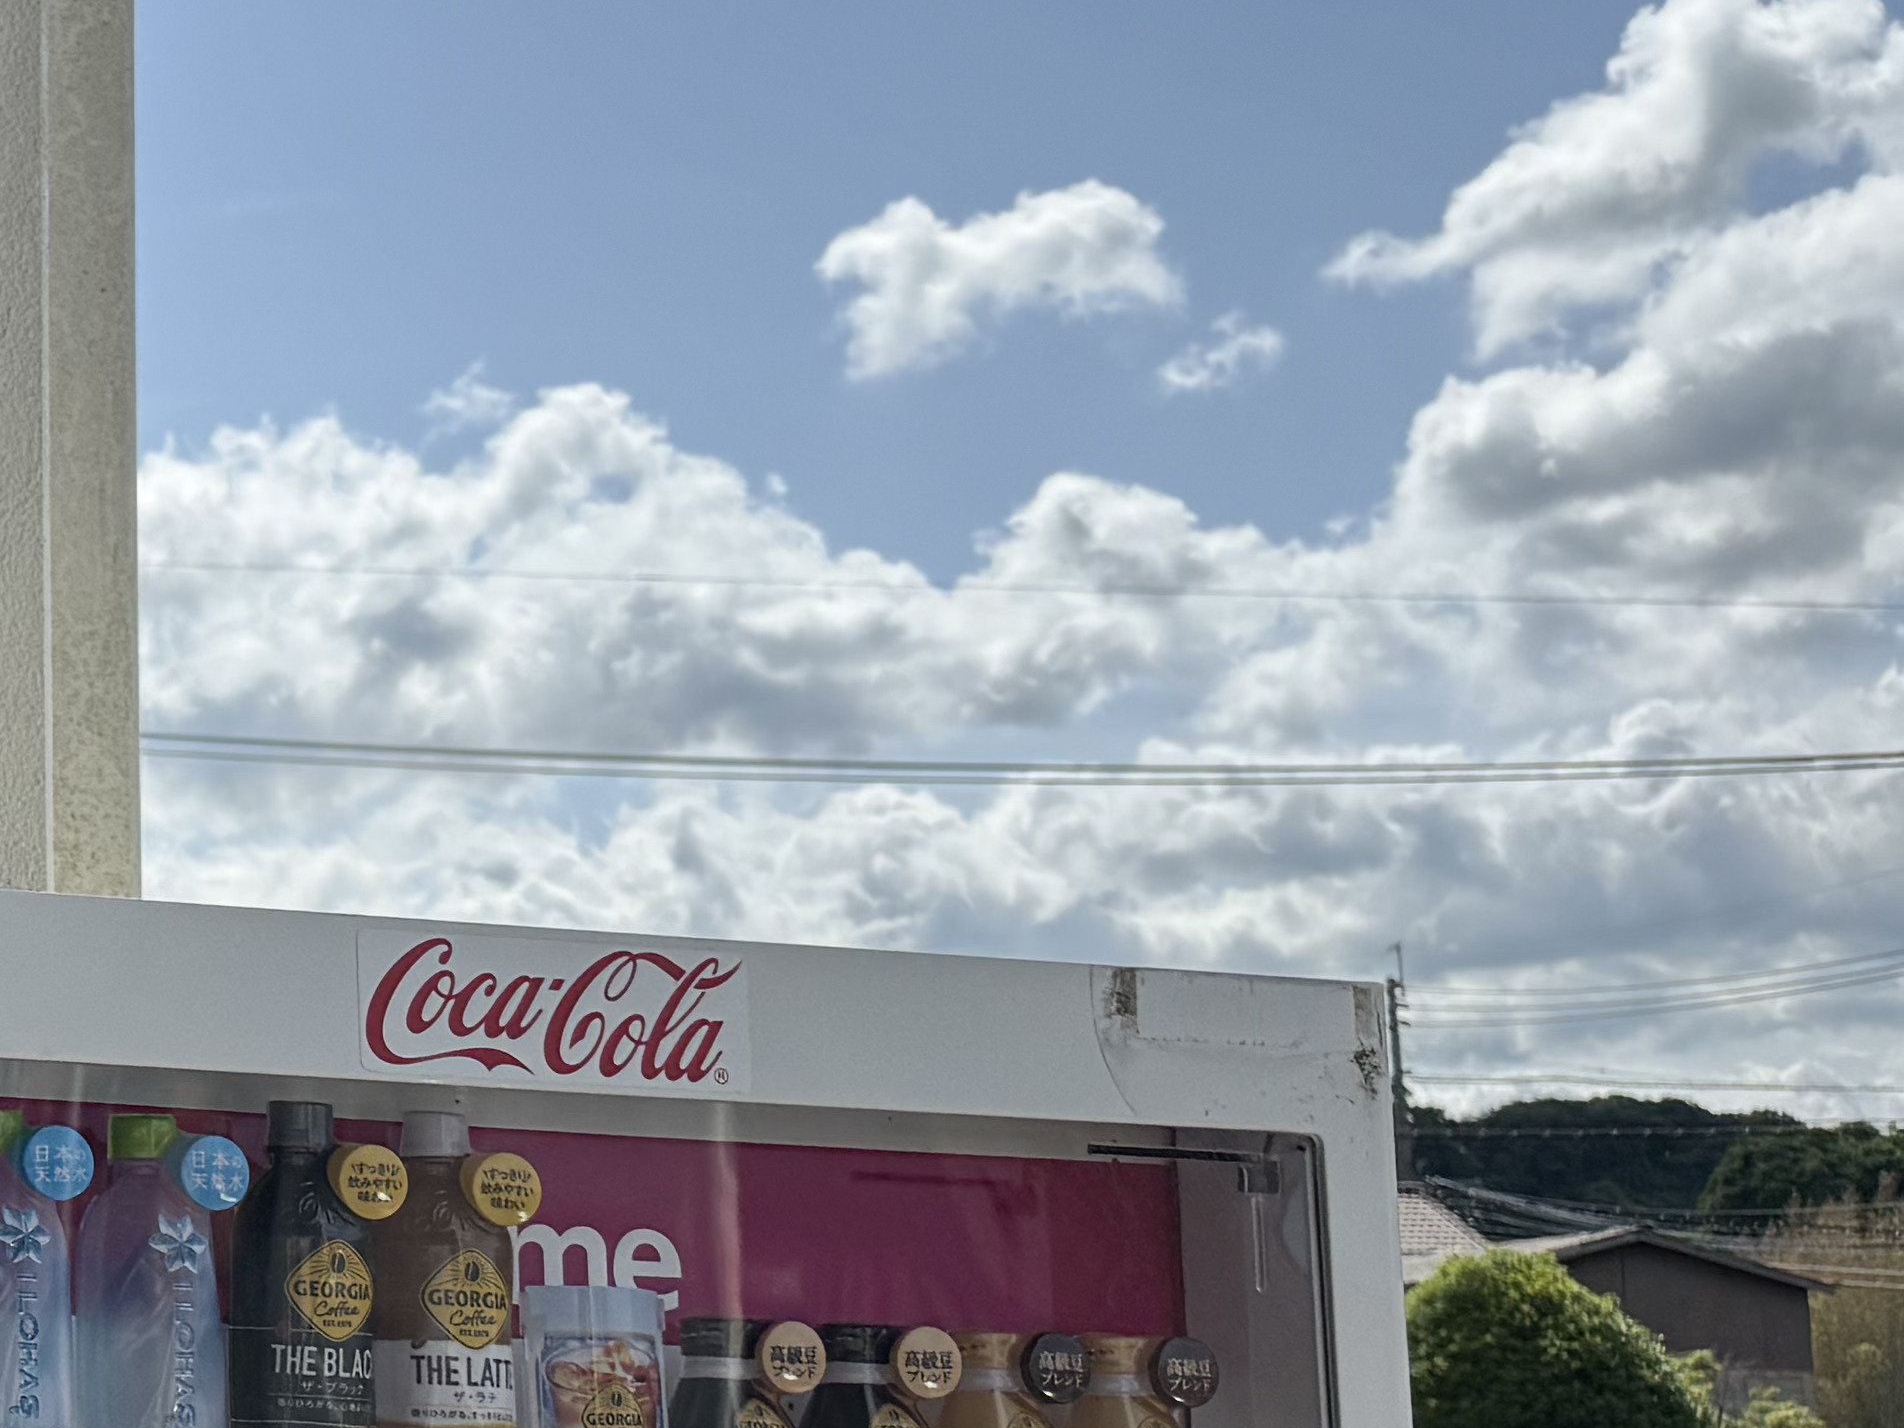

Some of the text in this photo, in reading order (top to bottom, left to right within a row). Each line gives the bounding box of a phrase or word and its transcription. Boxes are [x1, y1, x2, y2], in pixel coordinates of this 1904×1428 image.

[365, 937, 743, 1083] Coca-Cola
[35, 1145, 86, 1162] 日本の
[193, 1150, 242, 1169] 日本の
[35, 1166, 87, 1183] 天然水
[192, 1173, 243, 1191] 天然水
[294, 1281, 371, 1301] GEORGIA
[428, 1289, 507, 1310] GEORGIA
[314, 1300, 361, 1319] Coffee
[449, 1310, 497, 1328] Coffee
[272, 1344, 318, 1375] THE
[411, 1355, 459, 1386] THE
